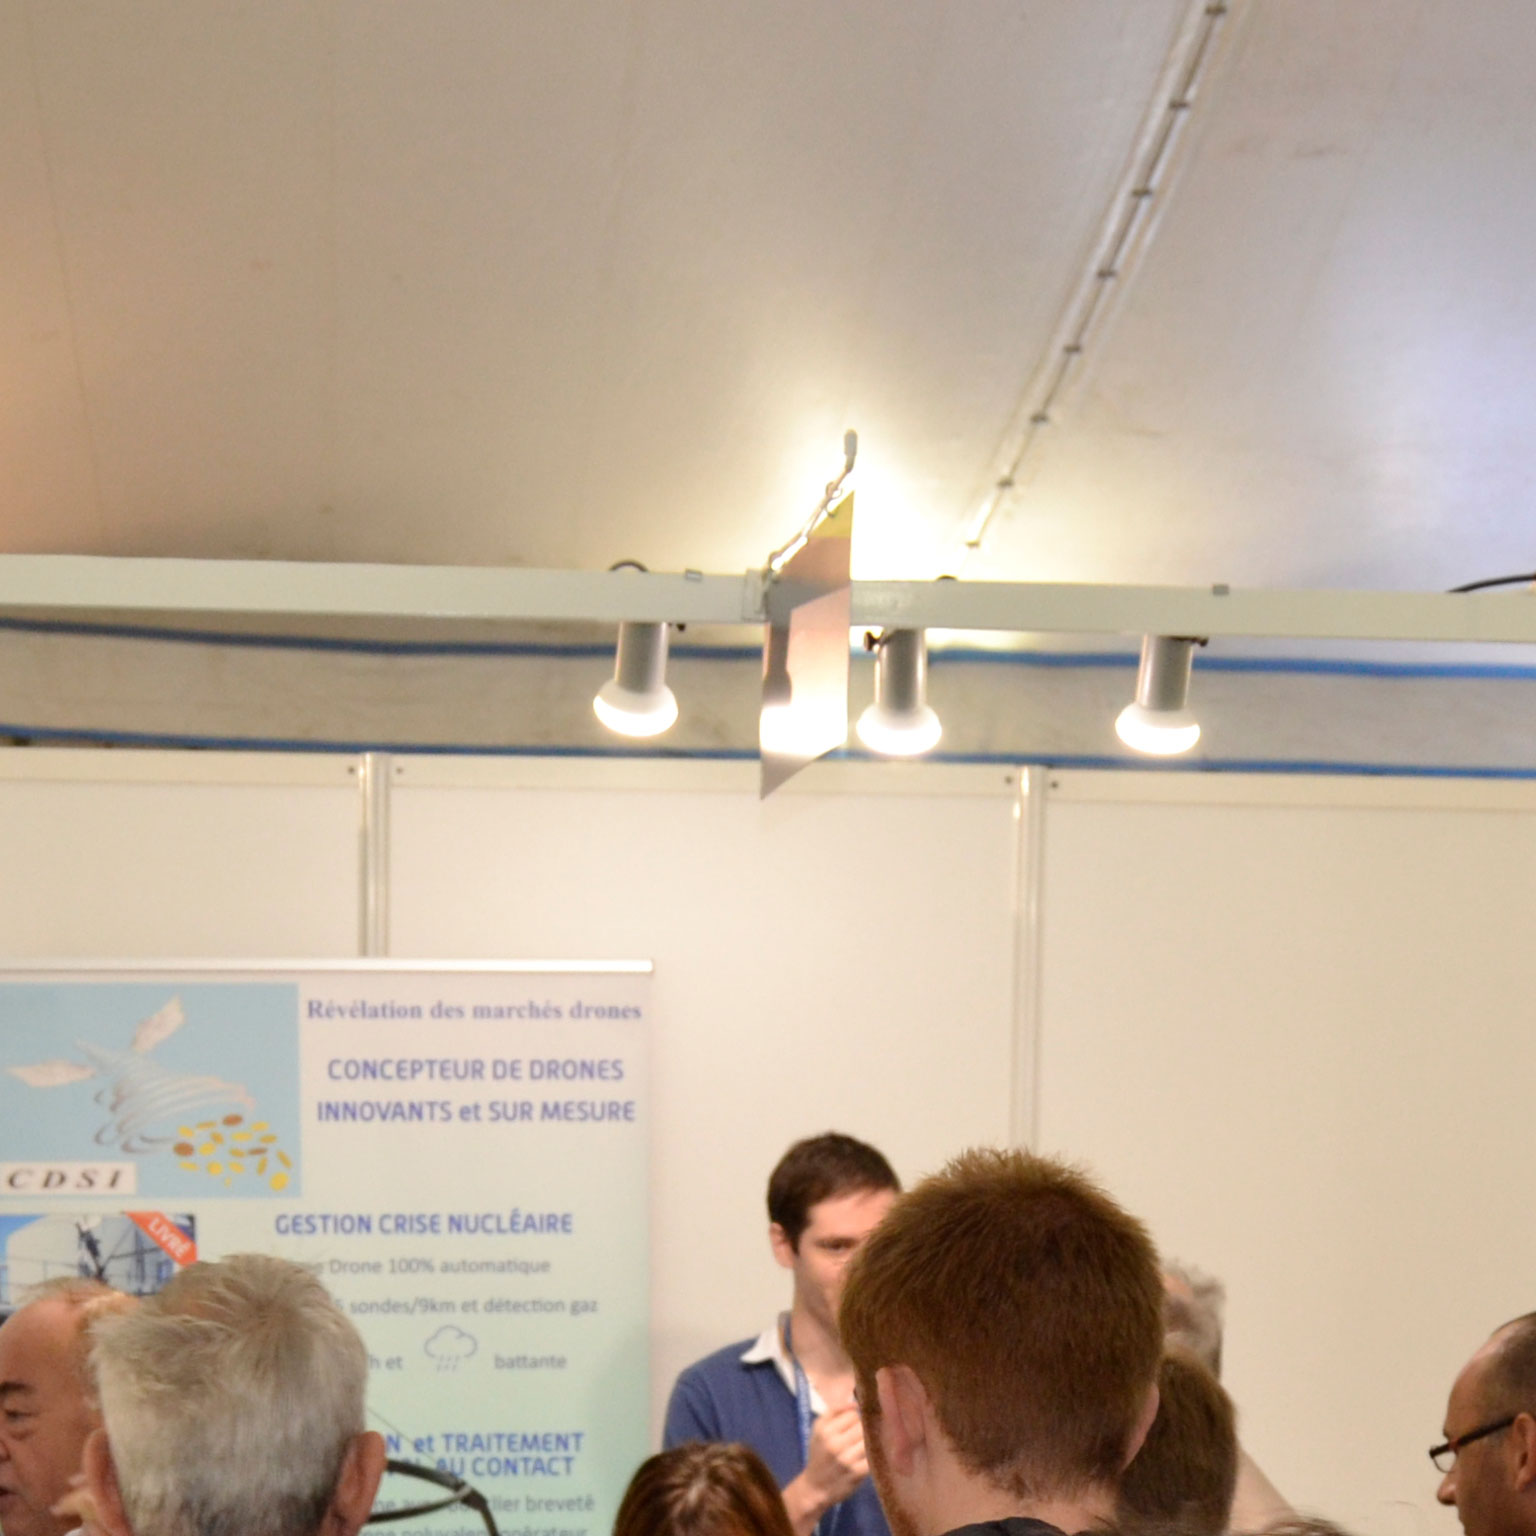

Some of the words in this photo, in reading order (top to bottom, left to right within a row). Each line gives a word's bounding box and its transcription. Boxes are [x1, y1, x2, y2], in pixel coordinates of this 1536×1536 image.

[307, 1000, 423, 1020] Révélation
[429, 1000, 465, 1020] des
[472, 1000, 563, 1020] marchés
[569, 1000, 642, 1020] drones
[327, 1059, 485, 1081] CONCEPTEUR
[492, 1059, 522, 1081] DE
[529, 1059, 624, 1081] DRONES
[317, 1101, 452, 1122] INNOVANTS
[459, 1102, 482, 1122] et
[489, 1101, 533, 1122] SUR
[540, 1101, 636, 1122] MESURE
[6, 1167, 124, 1191] CDSI
[275, 1213, 372, 1236] GESTION
[379, 1213, 442, 1235] CRISE
[448, 1208, 574, 1235] NUCLÉAIRE
[329, 1259, 382, 1275] Drone
[388, 1257, 435, 1275] 100%
[440, 1258, 551, 1276] automatique
[461, 1300, 481, 1315] et
[570, 1301, 598, 1317] gaz
[494, 1355, 568, 1371] battante
[414, 1436, 434, 1453] et
[442, 1432, 585, 1453] TRAITEMENT
[472, 1456, 575, 1477] CONTACT
